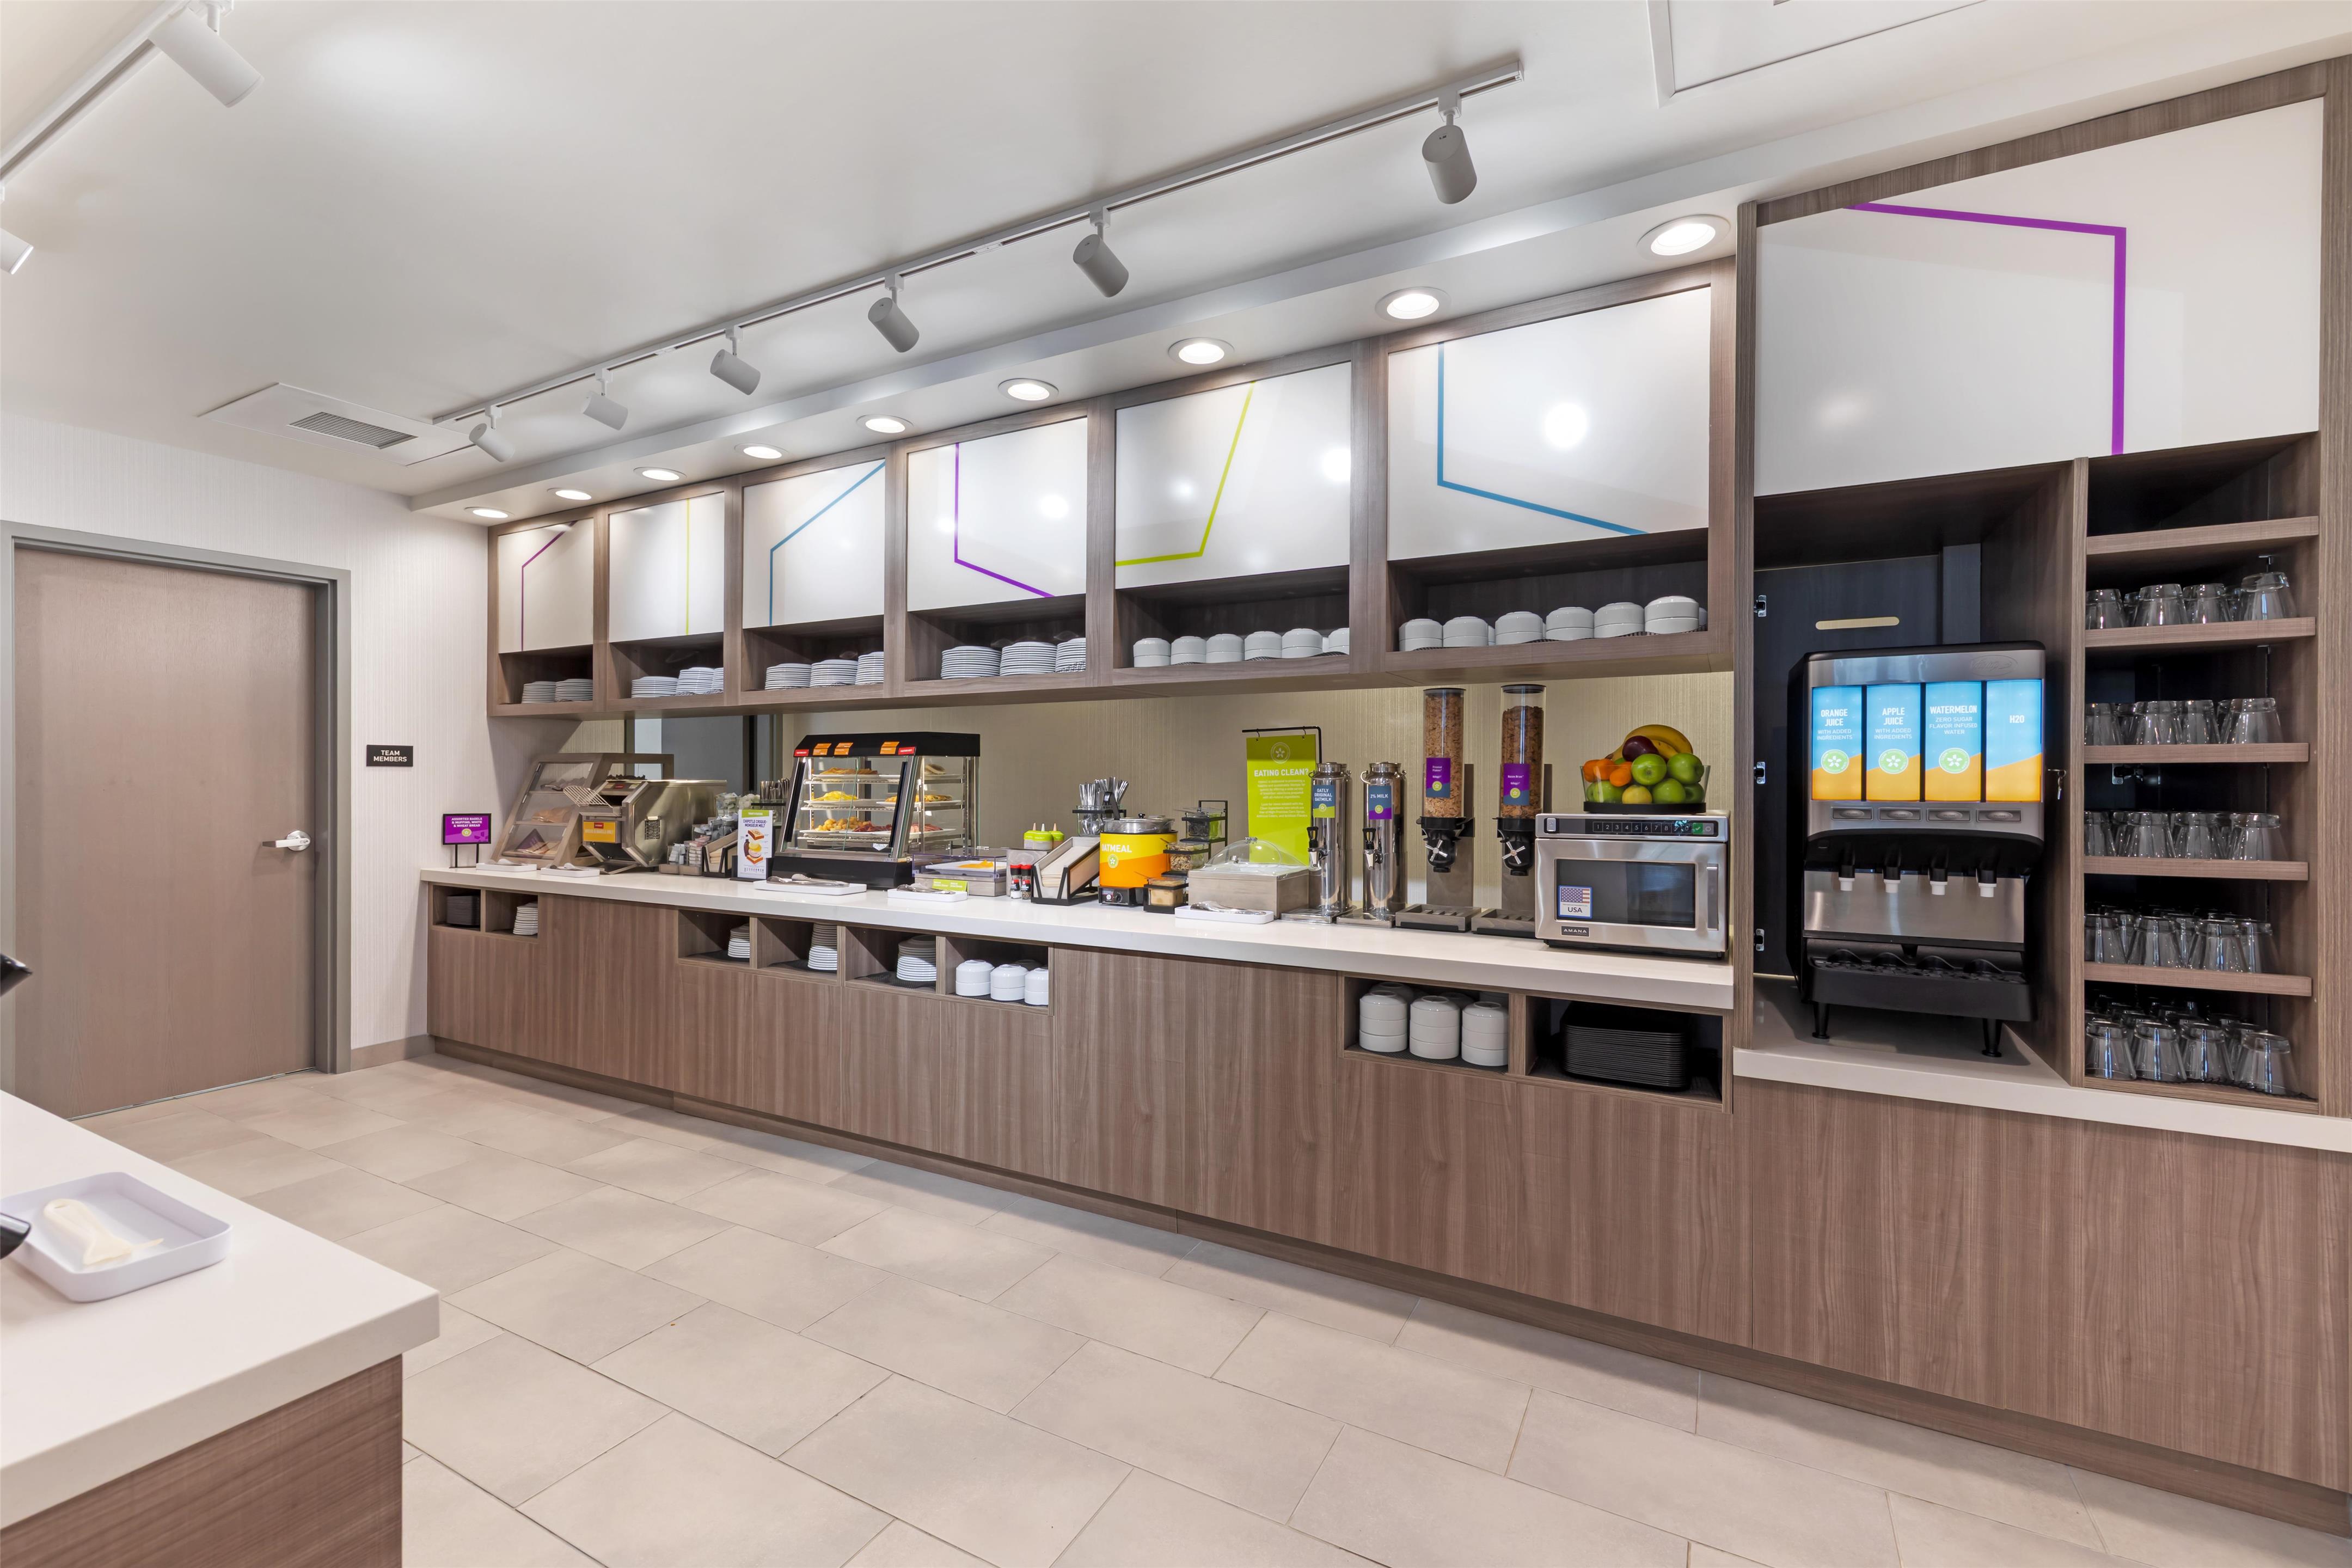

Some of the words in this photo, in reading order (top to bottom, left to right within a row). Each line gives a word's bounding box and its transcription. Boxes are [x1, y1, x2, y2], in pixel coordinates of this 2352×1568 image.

[1821, 709, 1848, 717] ORANGE
[1882, 707, 1905, 716] APPLE
[1930, 705, 1977, 714] WATERMELON
[1824, 718, 1844, 726] JUICE
[1883, 717, 1904, 725] JUICE
[1101, 844, 1132, 853] OATMEAL
